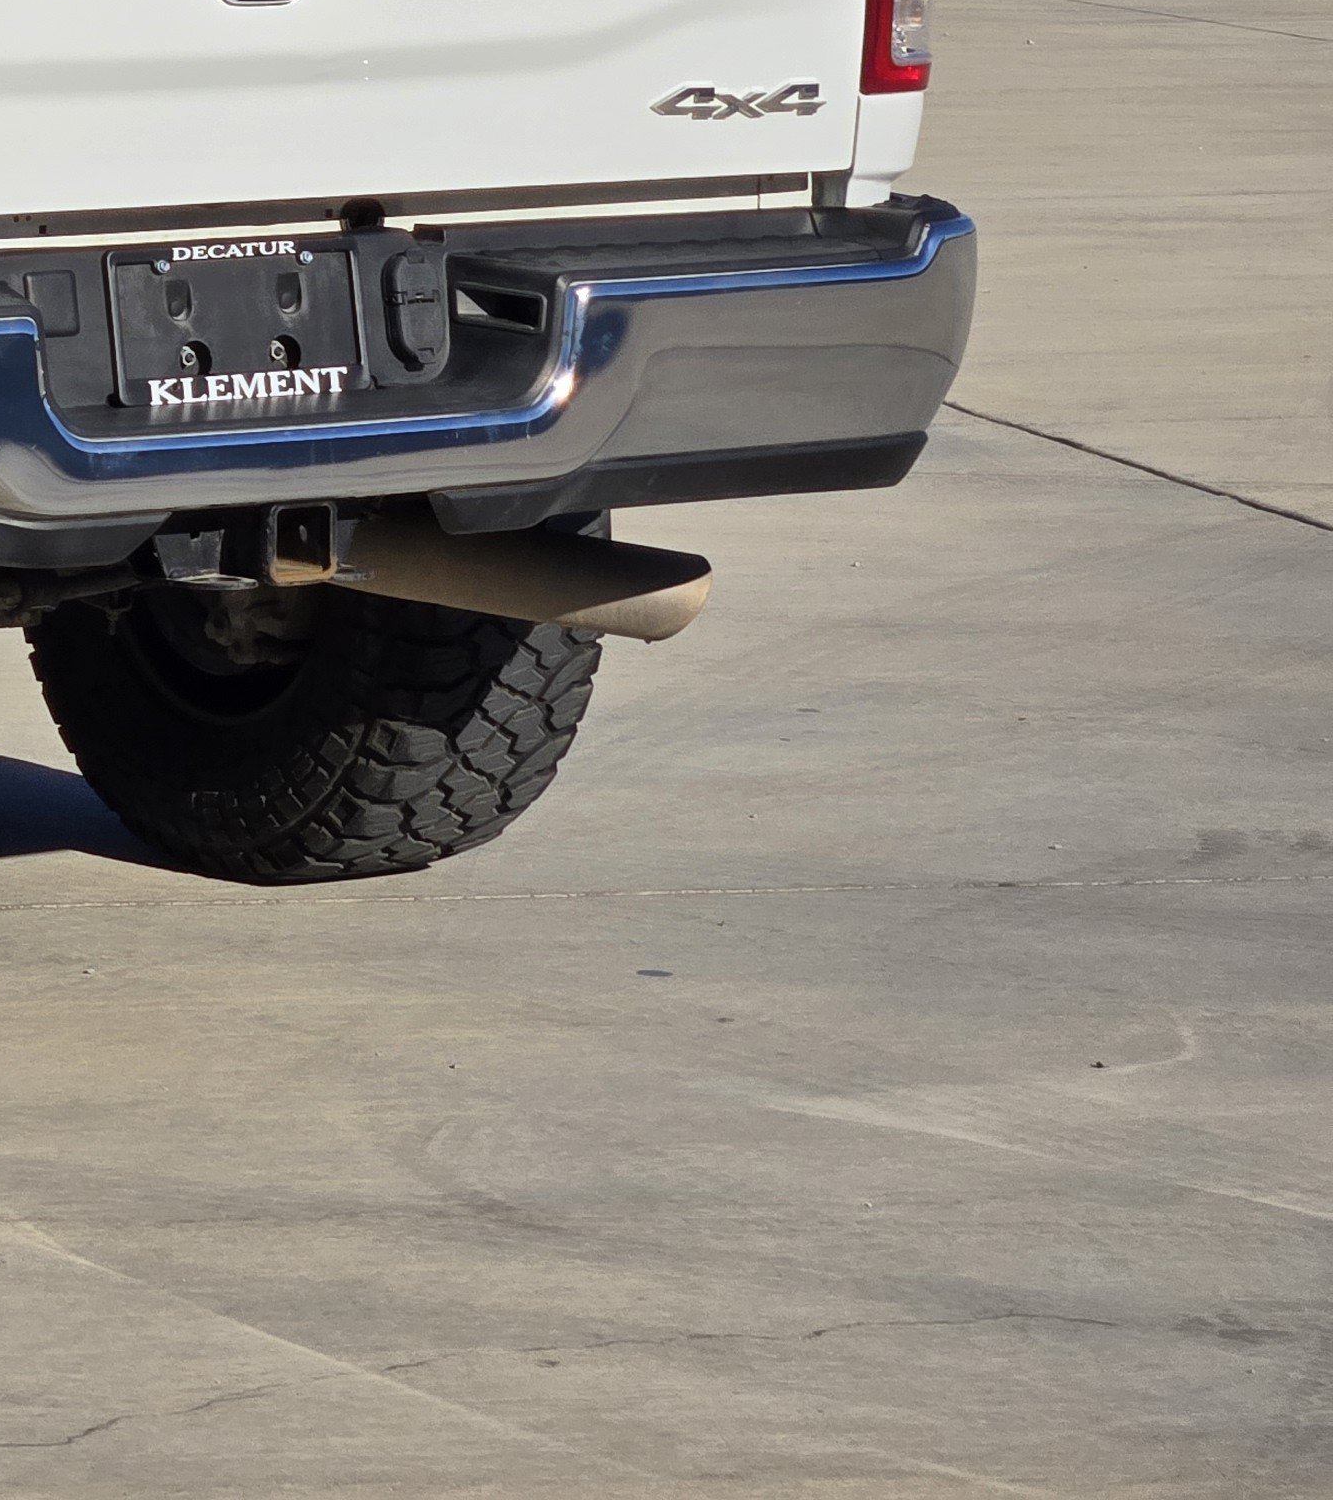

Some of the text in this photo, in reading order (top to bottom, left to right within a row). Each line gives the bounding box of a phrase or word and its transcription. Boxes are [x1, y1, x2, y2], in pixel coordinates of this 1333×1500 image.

[649, 82, 827, 120] 4x4
[172, 240, 296, 262] DECATUR
[148, 366, 348, 407] KLEMENT
